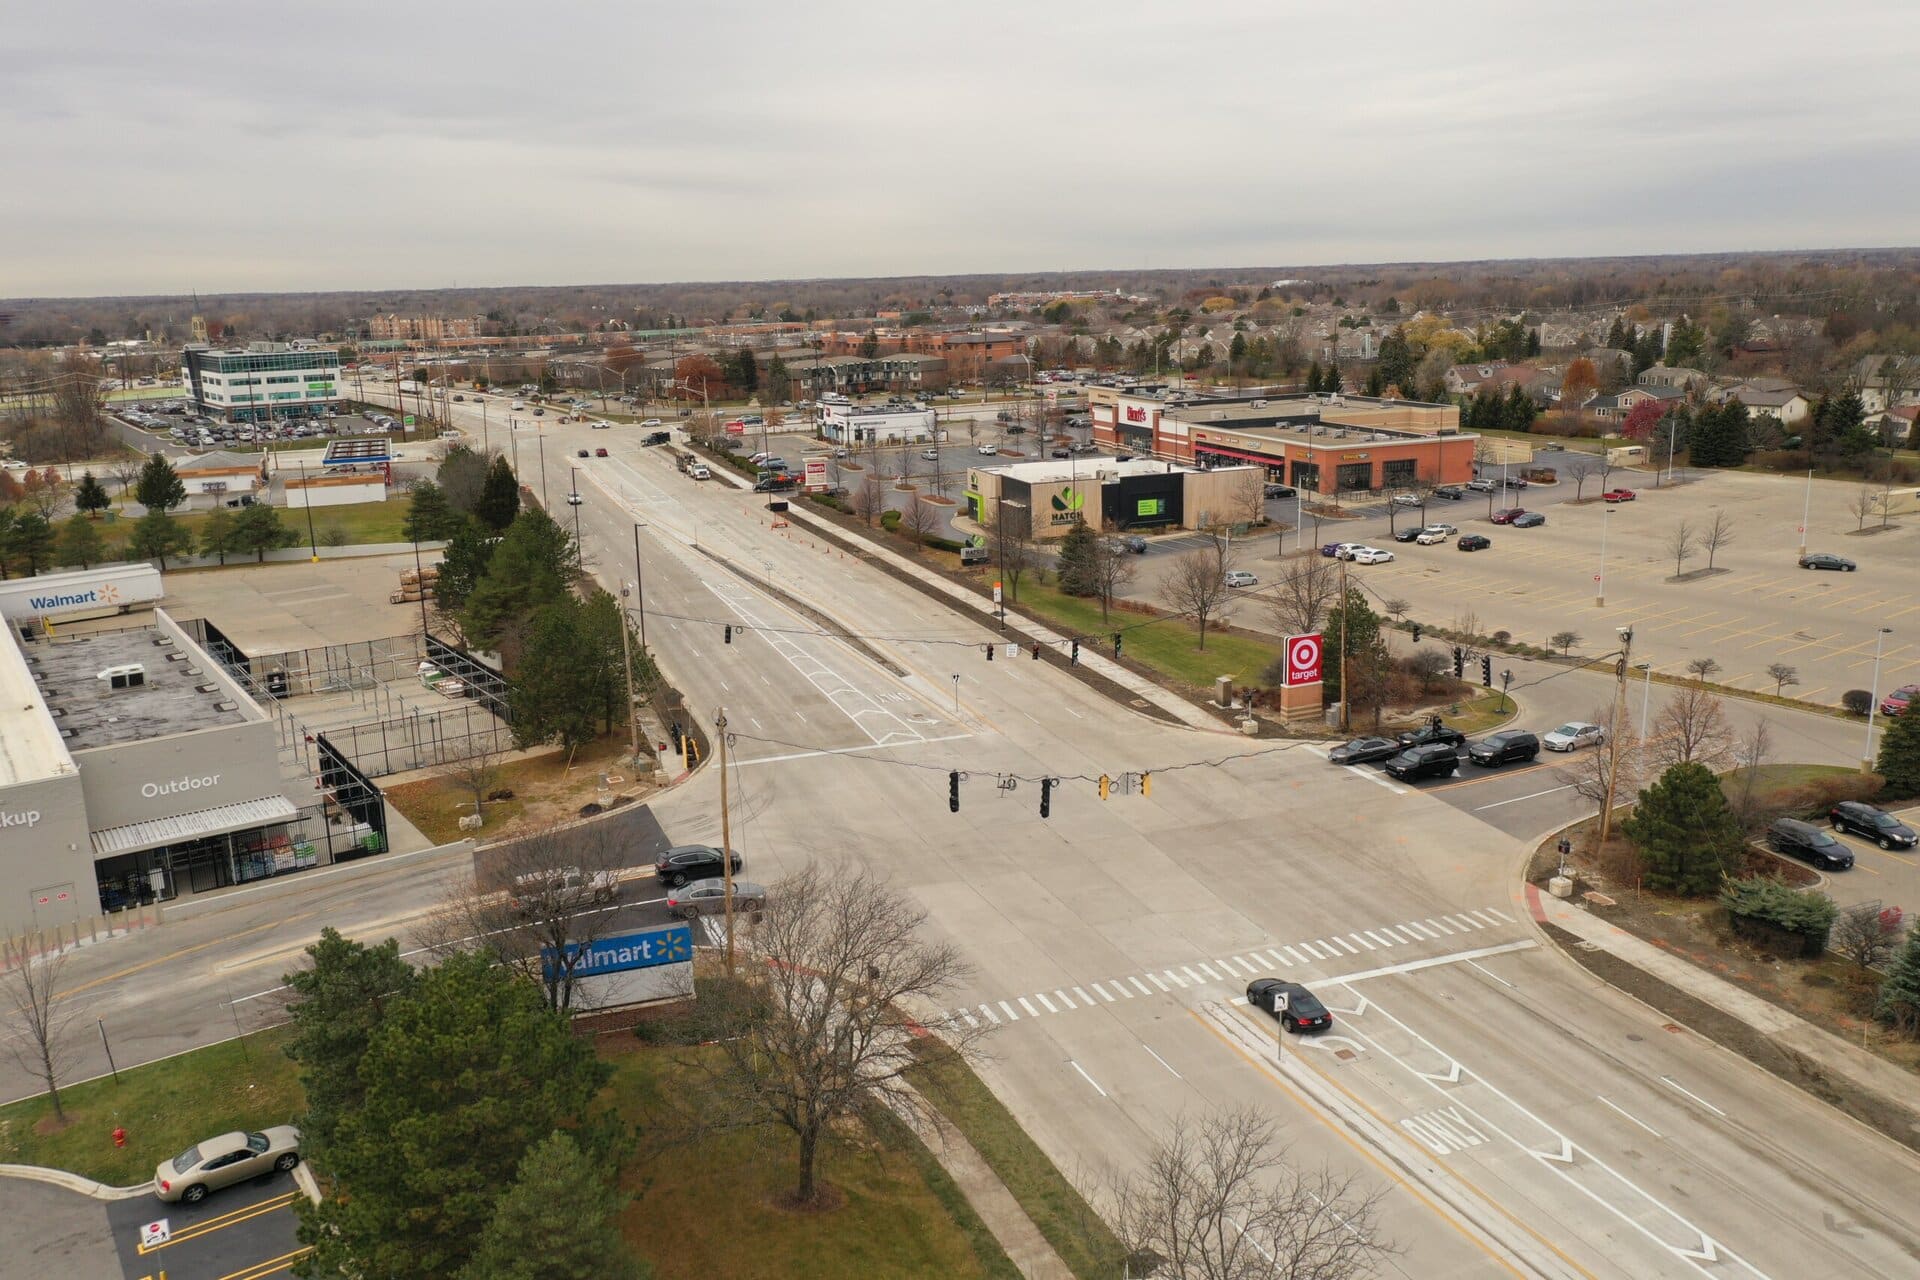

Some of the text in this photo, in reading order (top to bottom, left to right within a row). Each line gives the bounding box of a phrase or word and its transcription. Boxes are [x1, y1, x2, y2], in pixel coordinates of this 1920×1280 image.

[30, 590, 97, 609] Walmart
[1291, 668, 1318, 680] target
[141, 774, 220, 798] Outdoor
[0, 810, 41, 828] kup
[1400, 1105, 1491, 1155] ONLY
